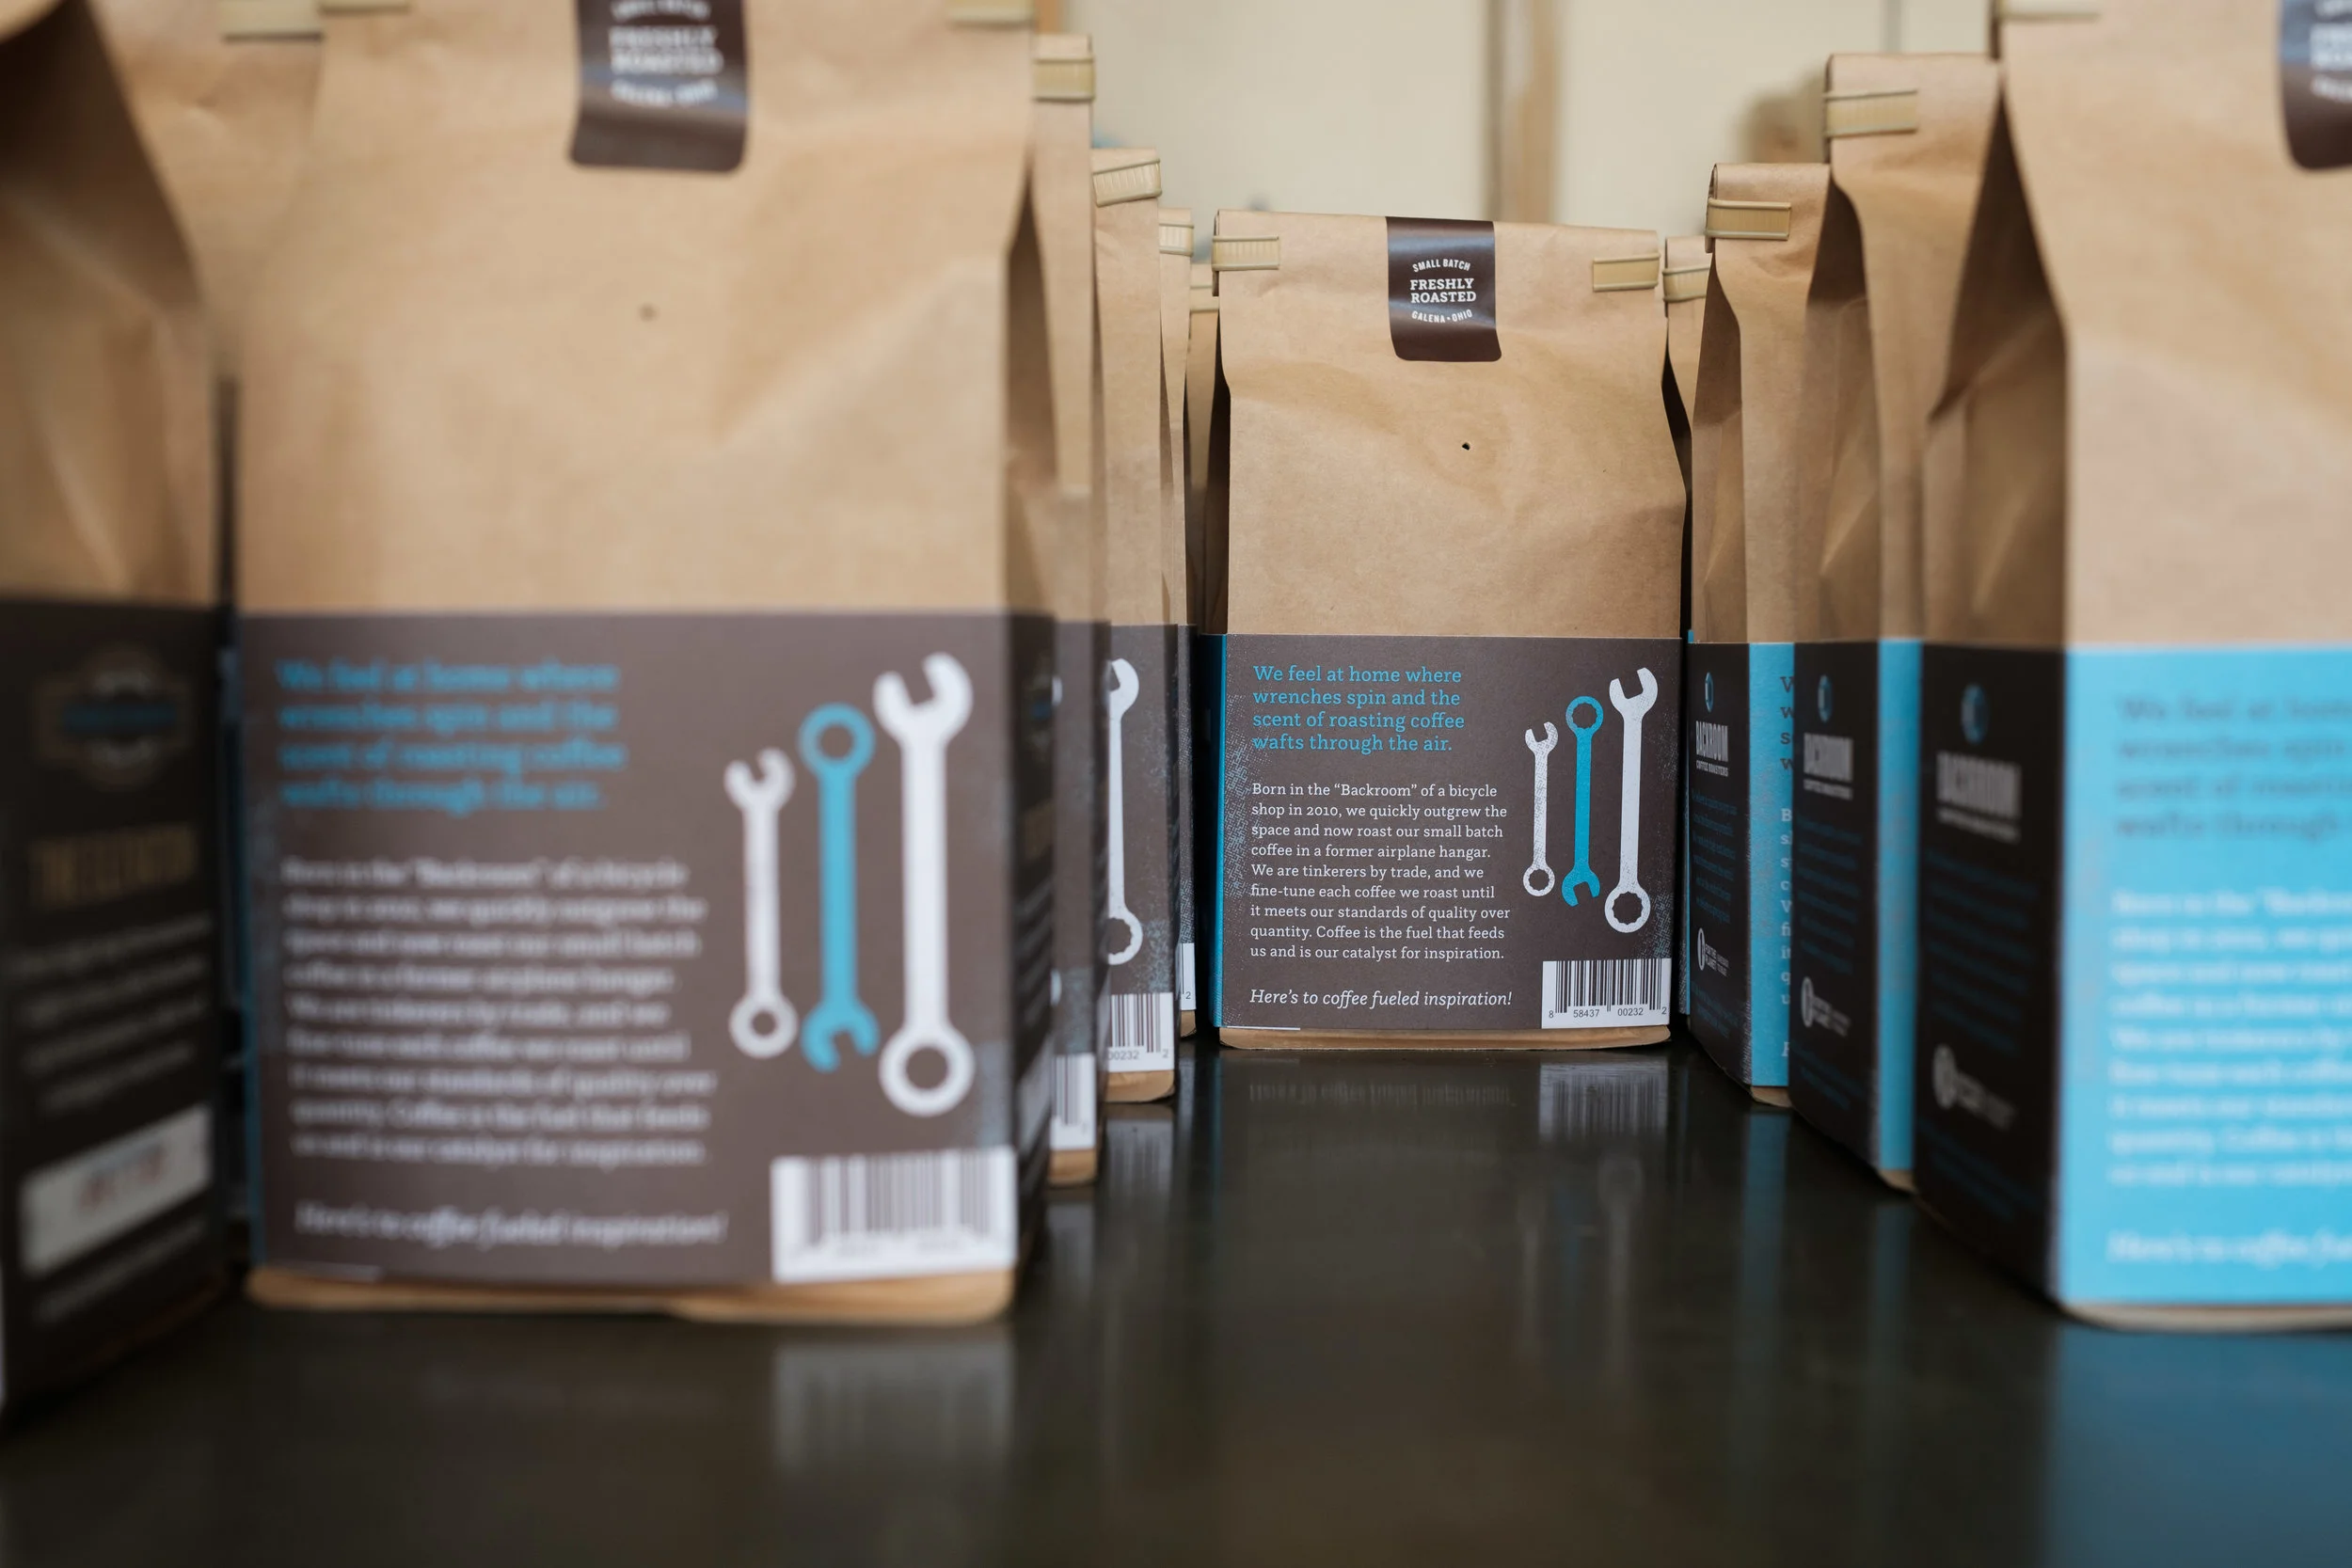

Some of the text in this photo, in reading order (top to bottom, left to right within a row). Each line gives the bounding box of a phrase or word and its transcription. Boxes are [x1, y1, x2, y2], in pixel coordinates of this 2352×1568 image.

[1412, 258, 1471, 273] SMALL BATCH
[1409, 277, 1474, 291] FRESHLY
[1410, 291, 1477, 304] ROASTED
[1411, 309, 1472, 324] GALENA OHIO
[1253, 664, 1462, 684] We feel at home where
[1252, 688, 1461, 709] wrenches spin and the
[1253, 710, 1465, 732] scent of roasting coffee
[1252, 733, 1451, 754] wafts through the air.
[1251, 783, 1287, 797] Born
[1289, 784, 1305, 796] in
[1307, 782, 1331, 797] the
[1421, 783, 1437, 797] of
[1438, 787, 1446, 798] a
[1448, 784, 1498, 800] bicycle
[1250, 803, 1507, 821] shop in 2010, we quickly outgrew the
[1250, 822, 1503, 840] space and now roast our small batch
[1250, 843, 1491, 862] coffee in a former airplane hangar.
[1250, 863, 1485, 881] We are tinkerers by trade, and we
[1249, 884, 1496, 899] fine-tune each coffee we roast until
[1249, 903, 1511, 923] it meets our standards of quality over
[1249, 925, 1505, 941] quantity. Coffee is the fuel that feeds
[1249, 944, 1504, 964] us and is our catalyst for inspiration.
[1185, 991, 1191, 1000] 2
[1302, 991, 1319, 1005] to
[1322, 990, 1369, 1009] coffee
[1370, 990, 1421, 1010] fueled
[1423, 990, 1513, 1010] inspiration!
[1549, 1006, 1667, 1019] 8 58437 00232 2
